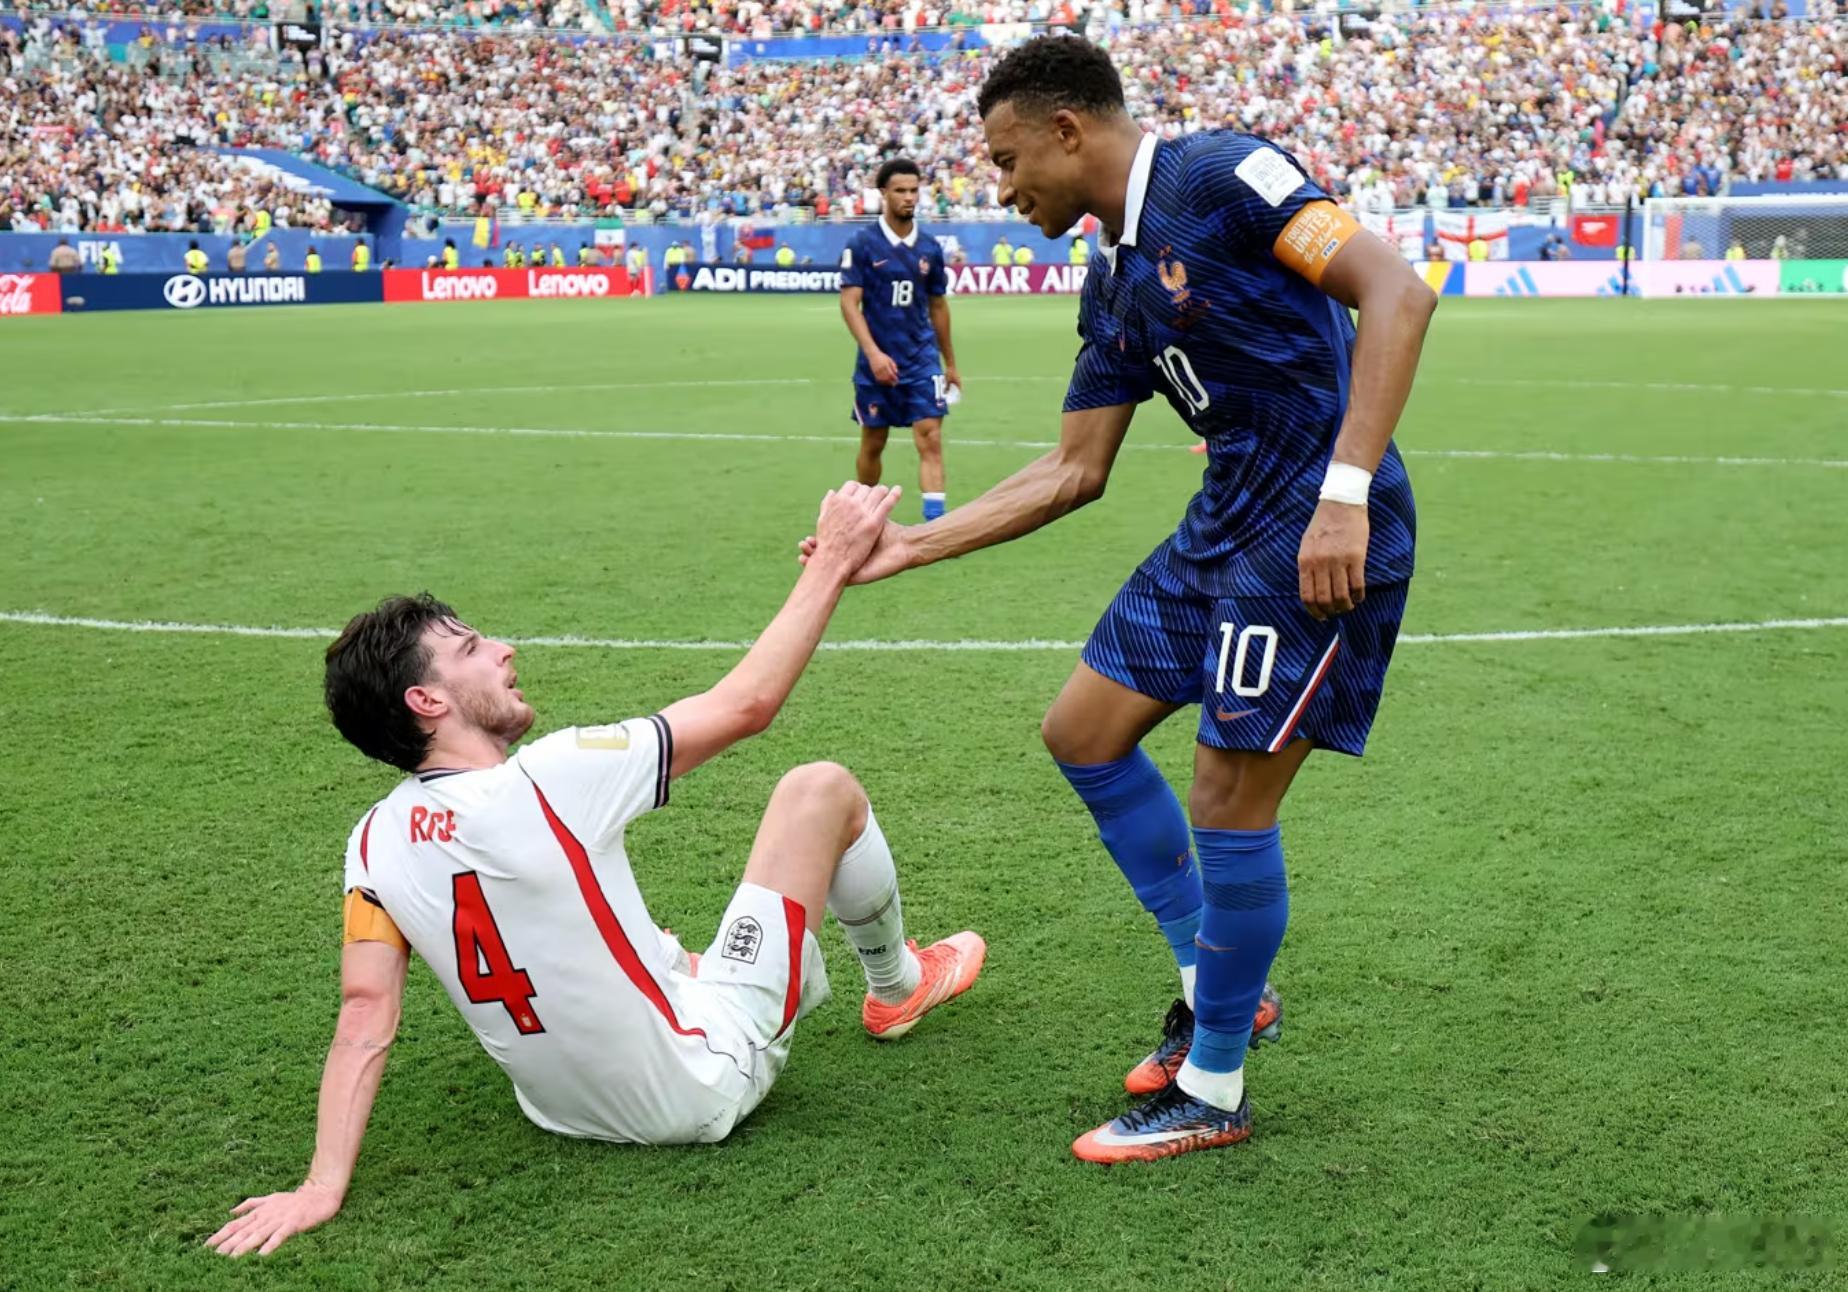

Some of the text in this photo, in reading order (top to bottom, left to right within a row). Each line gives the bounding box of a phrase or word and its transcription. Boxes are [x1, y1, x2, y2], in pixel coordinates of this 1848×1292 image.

[1291, 208, 1332, 254] UNITES
[208, 276, 305, 304] HYUNDAI
[421, 271, 498, 300] Lenovo
[527, 269, 610, 298] Lenovo
[692, 267, 747, 292] ADI
[891, 280, 914, 306] 18
[1153, 345, 1210, 416] 10
[1216, 621, 1279, 697] 10
[452, 870, 547, 1036] 4
